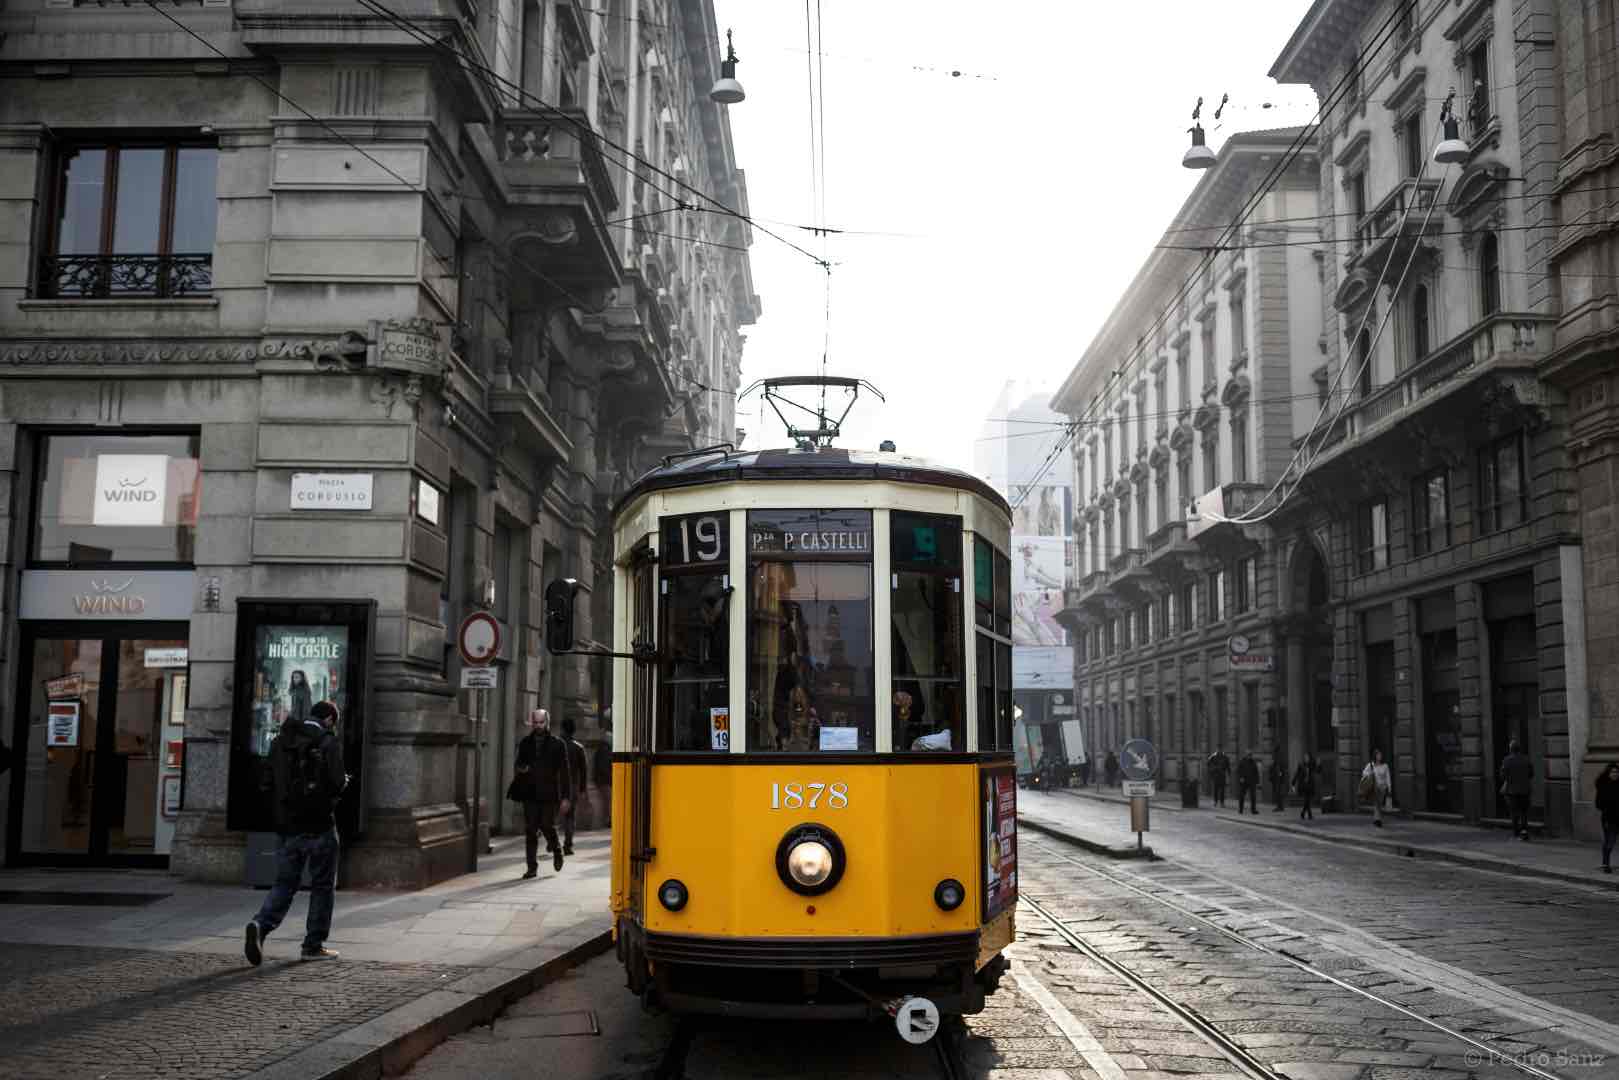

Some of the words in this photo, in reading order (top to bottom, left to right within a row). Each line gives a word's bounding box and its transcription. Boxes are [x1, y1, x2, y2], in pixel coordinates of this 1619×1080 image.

[104, 490, 157, 502] WIND
[680, 516, 721, 562] 19
[801, 532, 868, 550] CASTELLI
[74, 596, 144, 615] WIND
[269, 643, 297, 658] HIGH
[299, 643, 339, 658] CASTLE
[769, 783, 849, 809] 1878
